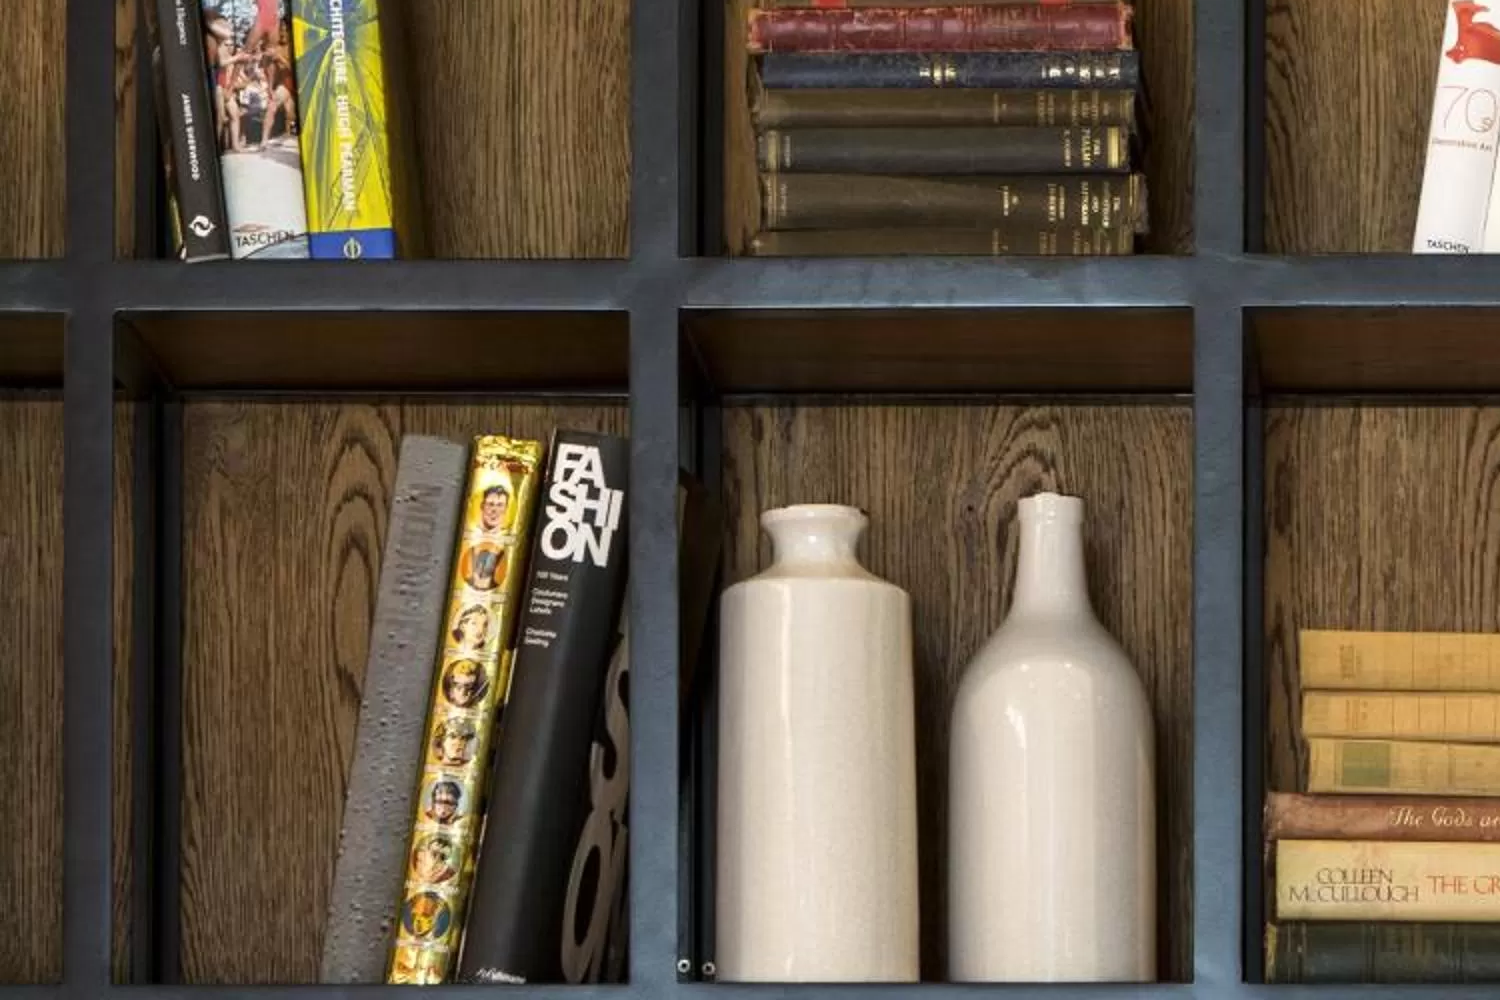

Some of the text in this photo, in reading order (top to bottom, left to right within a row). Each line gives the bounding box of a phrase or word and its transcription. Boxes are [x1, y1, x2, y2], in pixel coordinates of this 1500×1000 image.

[1440, 85, 1497, 134] 70s
[235, 229, 295, 248] TASCHEN
[1389, 806, 1423, 827] The
[1431, 806, 1474, 828] Gods
[1316, 867, 1393, 884] COLLEEN
[1425, 875, 1469, 895] THE
